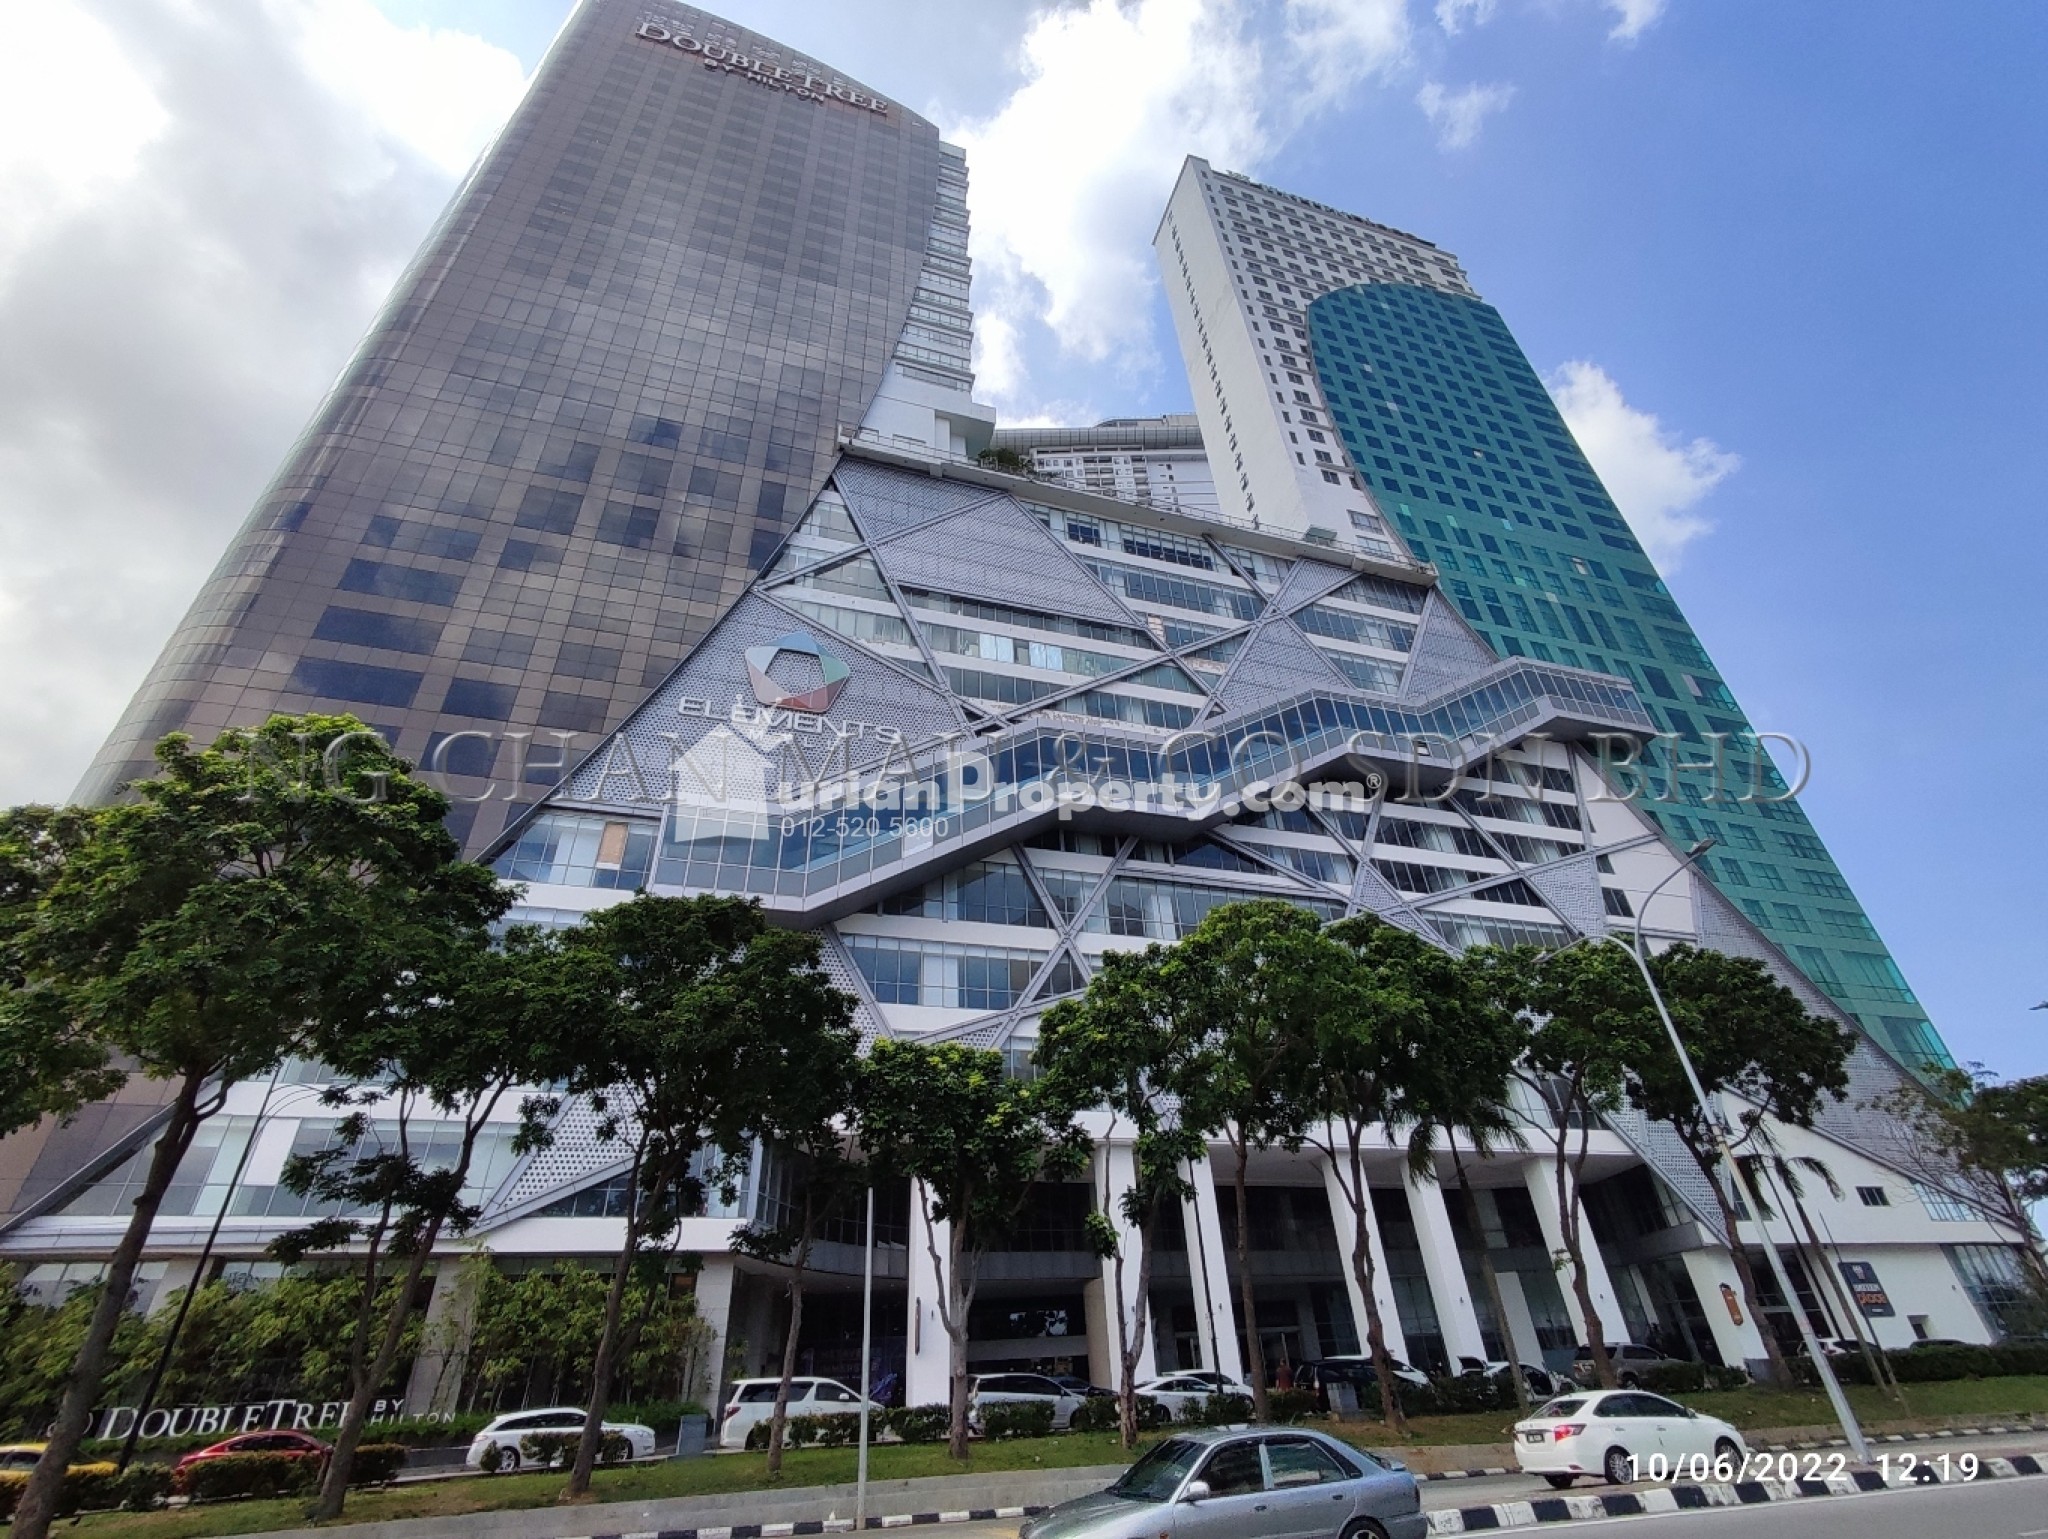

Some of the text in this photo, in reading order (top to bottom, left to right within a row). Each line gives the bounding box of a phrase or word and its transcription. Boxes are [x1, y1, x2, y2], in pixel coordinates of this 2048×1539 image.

[635, 22, 887, 114] DOUBLETREE
[704, 58, 825, 103] BY HILTON
[678, 696, 903, 745] ELEMENTS
[369, 1412, 456, 1427] HILTON
[373, 1398, 405, 1412] BY
